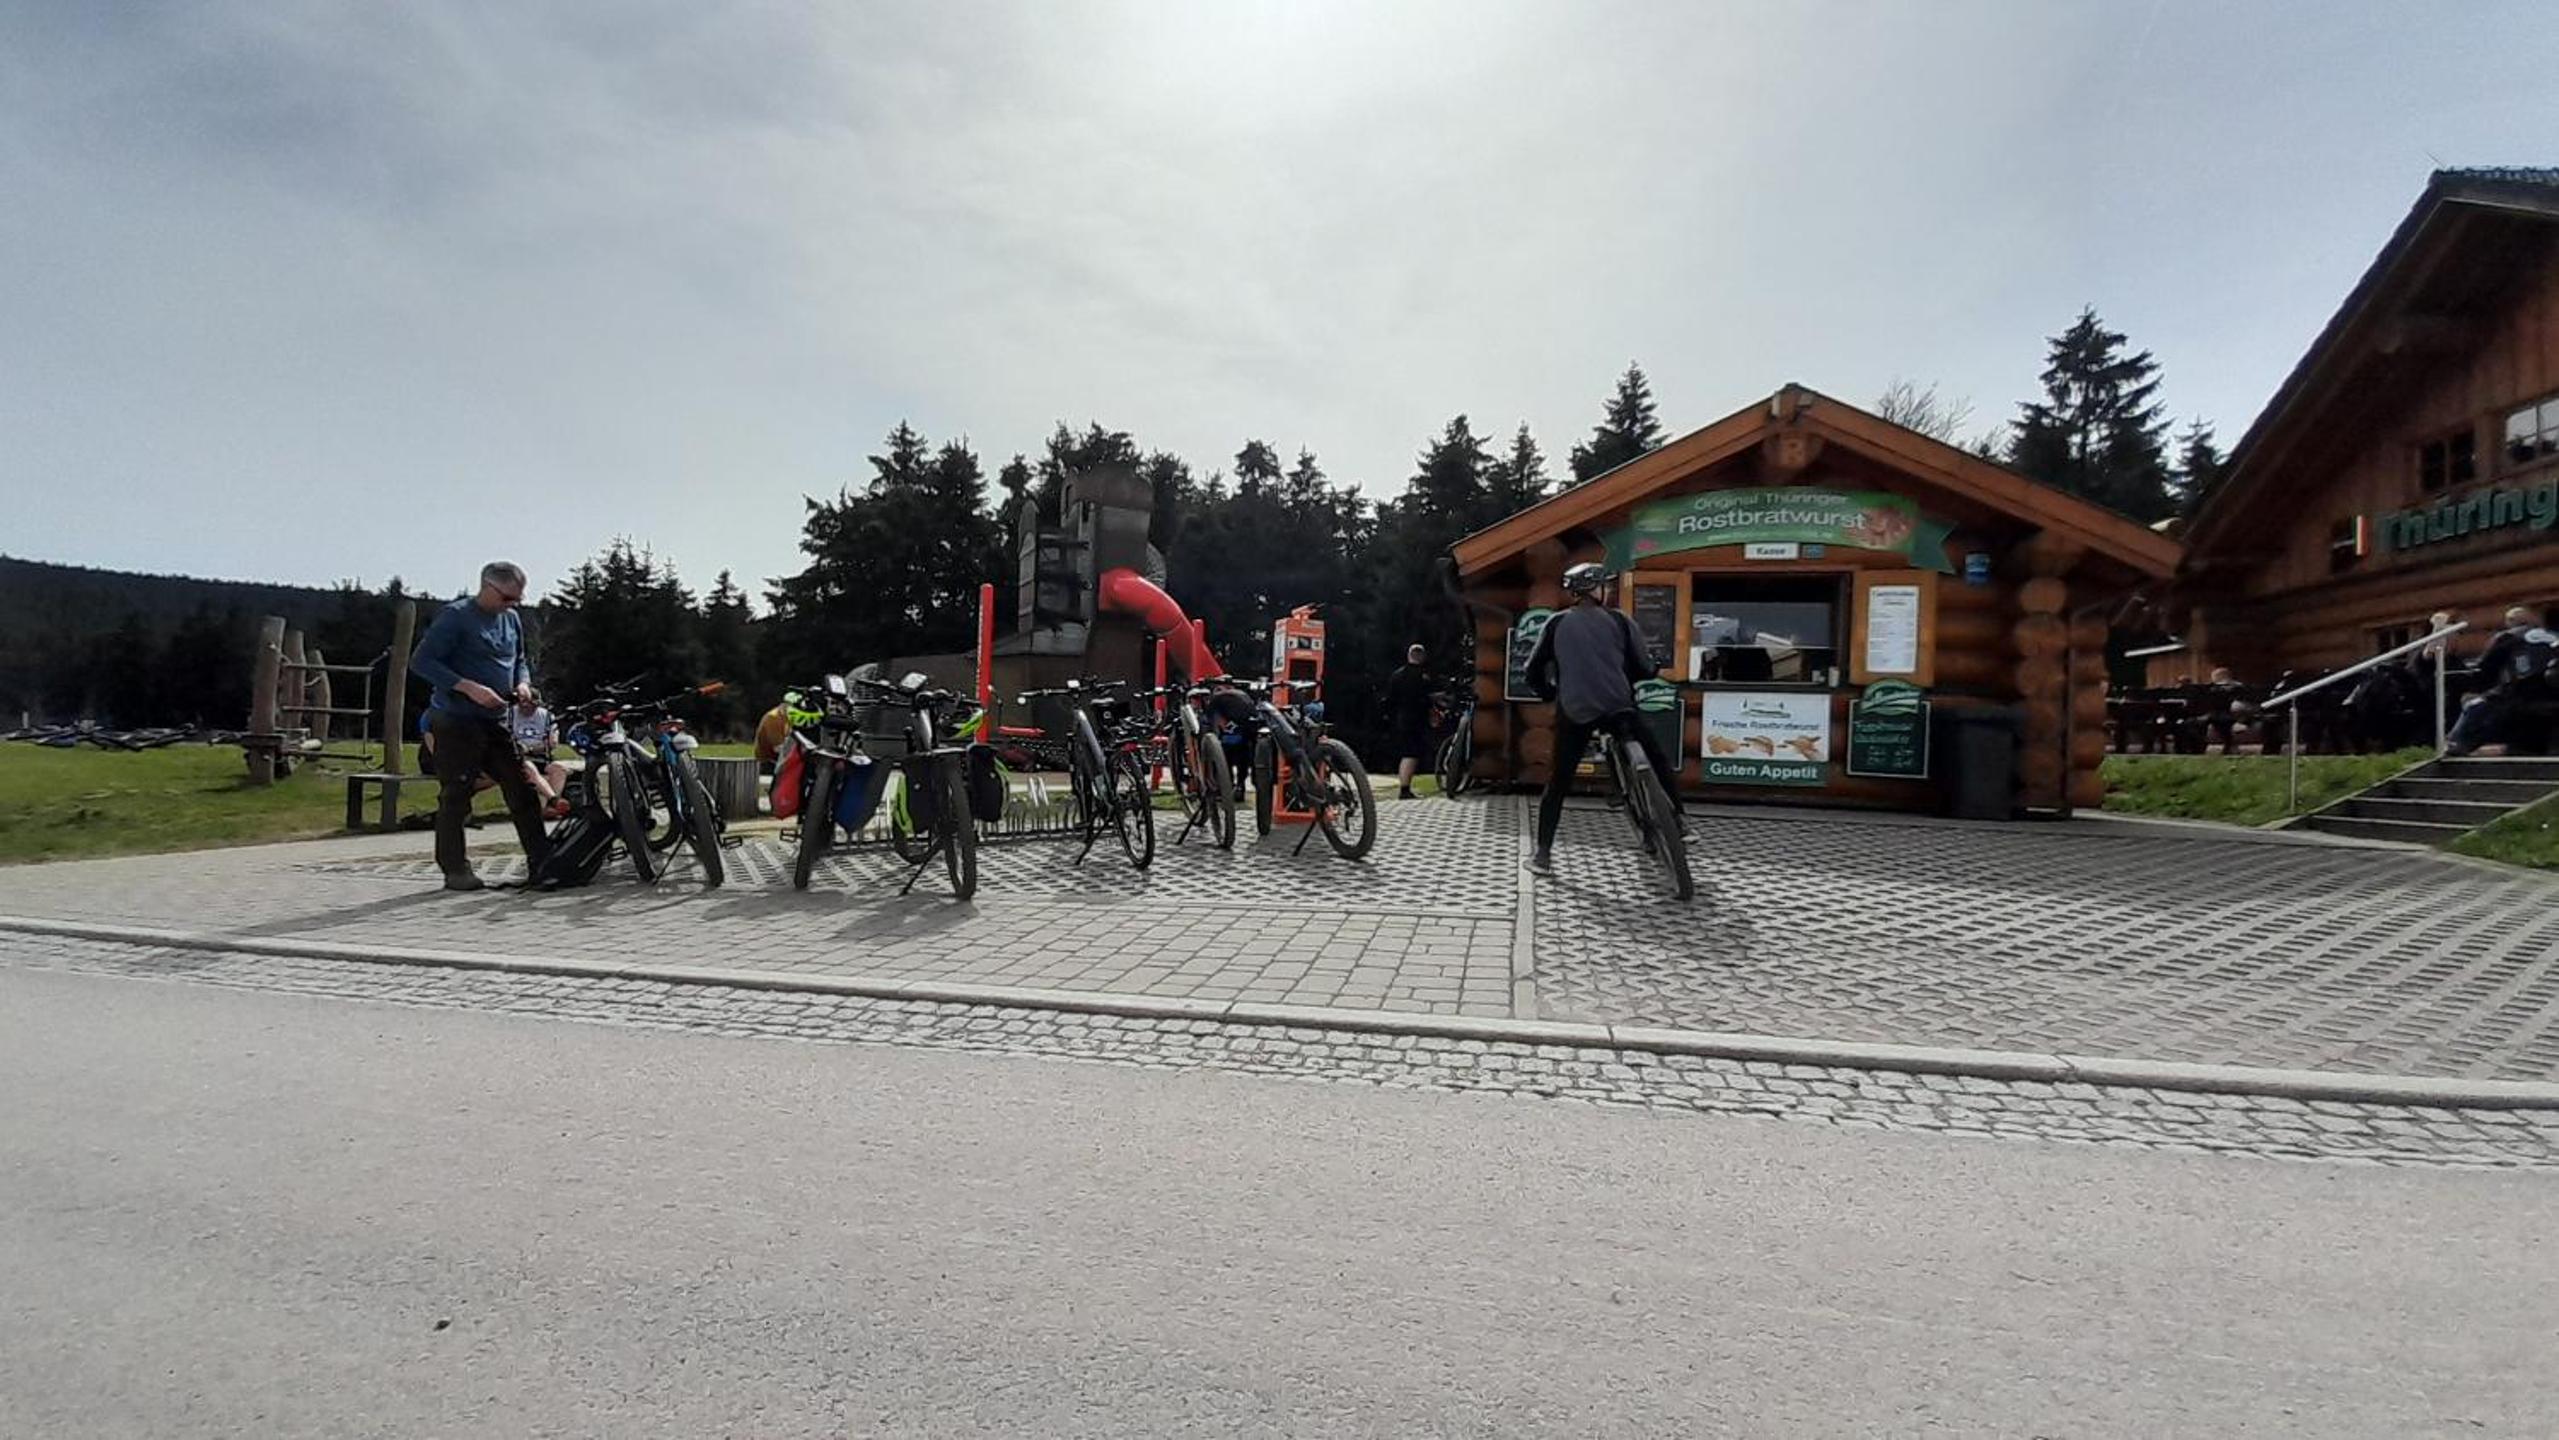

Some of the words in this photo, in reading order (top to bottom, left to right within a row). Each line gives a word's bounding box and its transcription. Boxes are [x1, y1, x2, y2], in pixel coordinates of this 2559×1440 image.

[1694, 493, 1758, 510] Original
[1678, 507, 1867, 535] Rostbratwurst
[1710, 761, 1757, 776] Guten
[1760, 764, 1818, 780] Appetit
